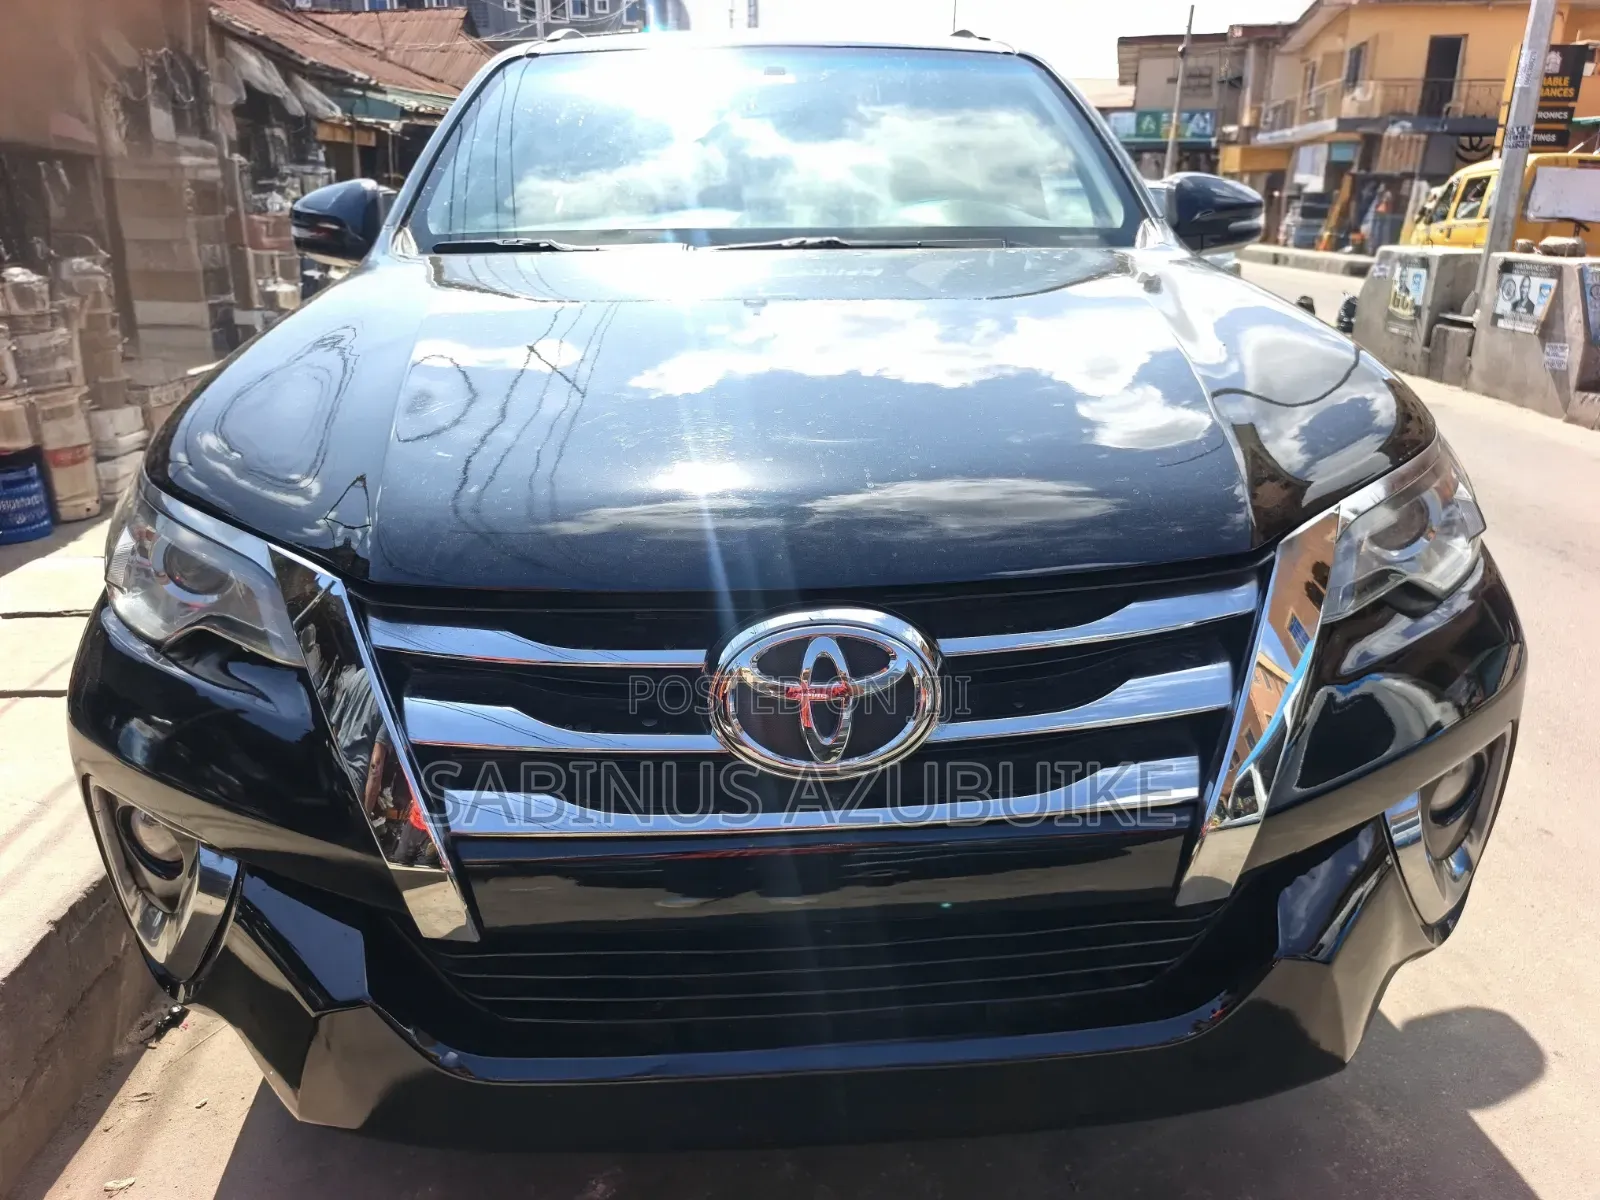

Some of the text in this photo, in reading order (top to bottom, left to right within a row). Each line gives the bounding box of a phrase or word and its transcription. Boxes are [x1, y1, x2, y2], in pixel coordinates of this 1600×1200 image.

[1542, 76, 1570, 87] IABLE
[1540, 87, 1575, 98] IANCES
[1537, 111, 1569, 120] RONICS
[1533, 133, 1557, 143] TINGS
